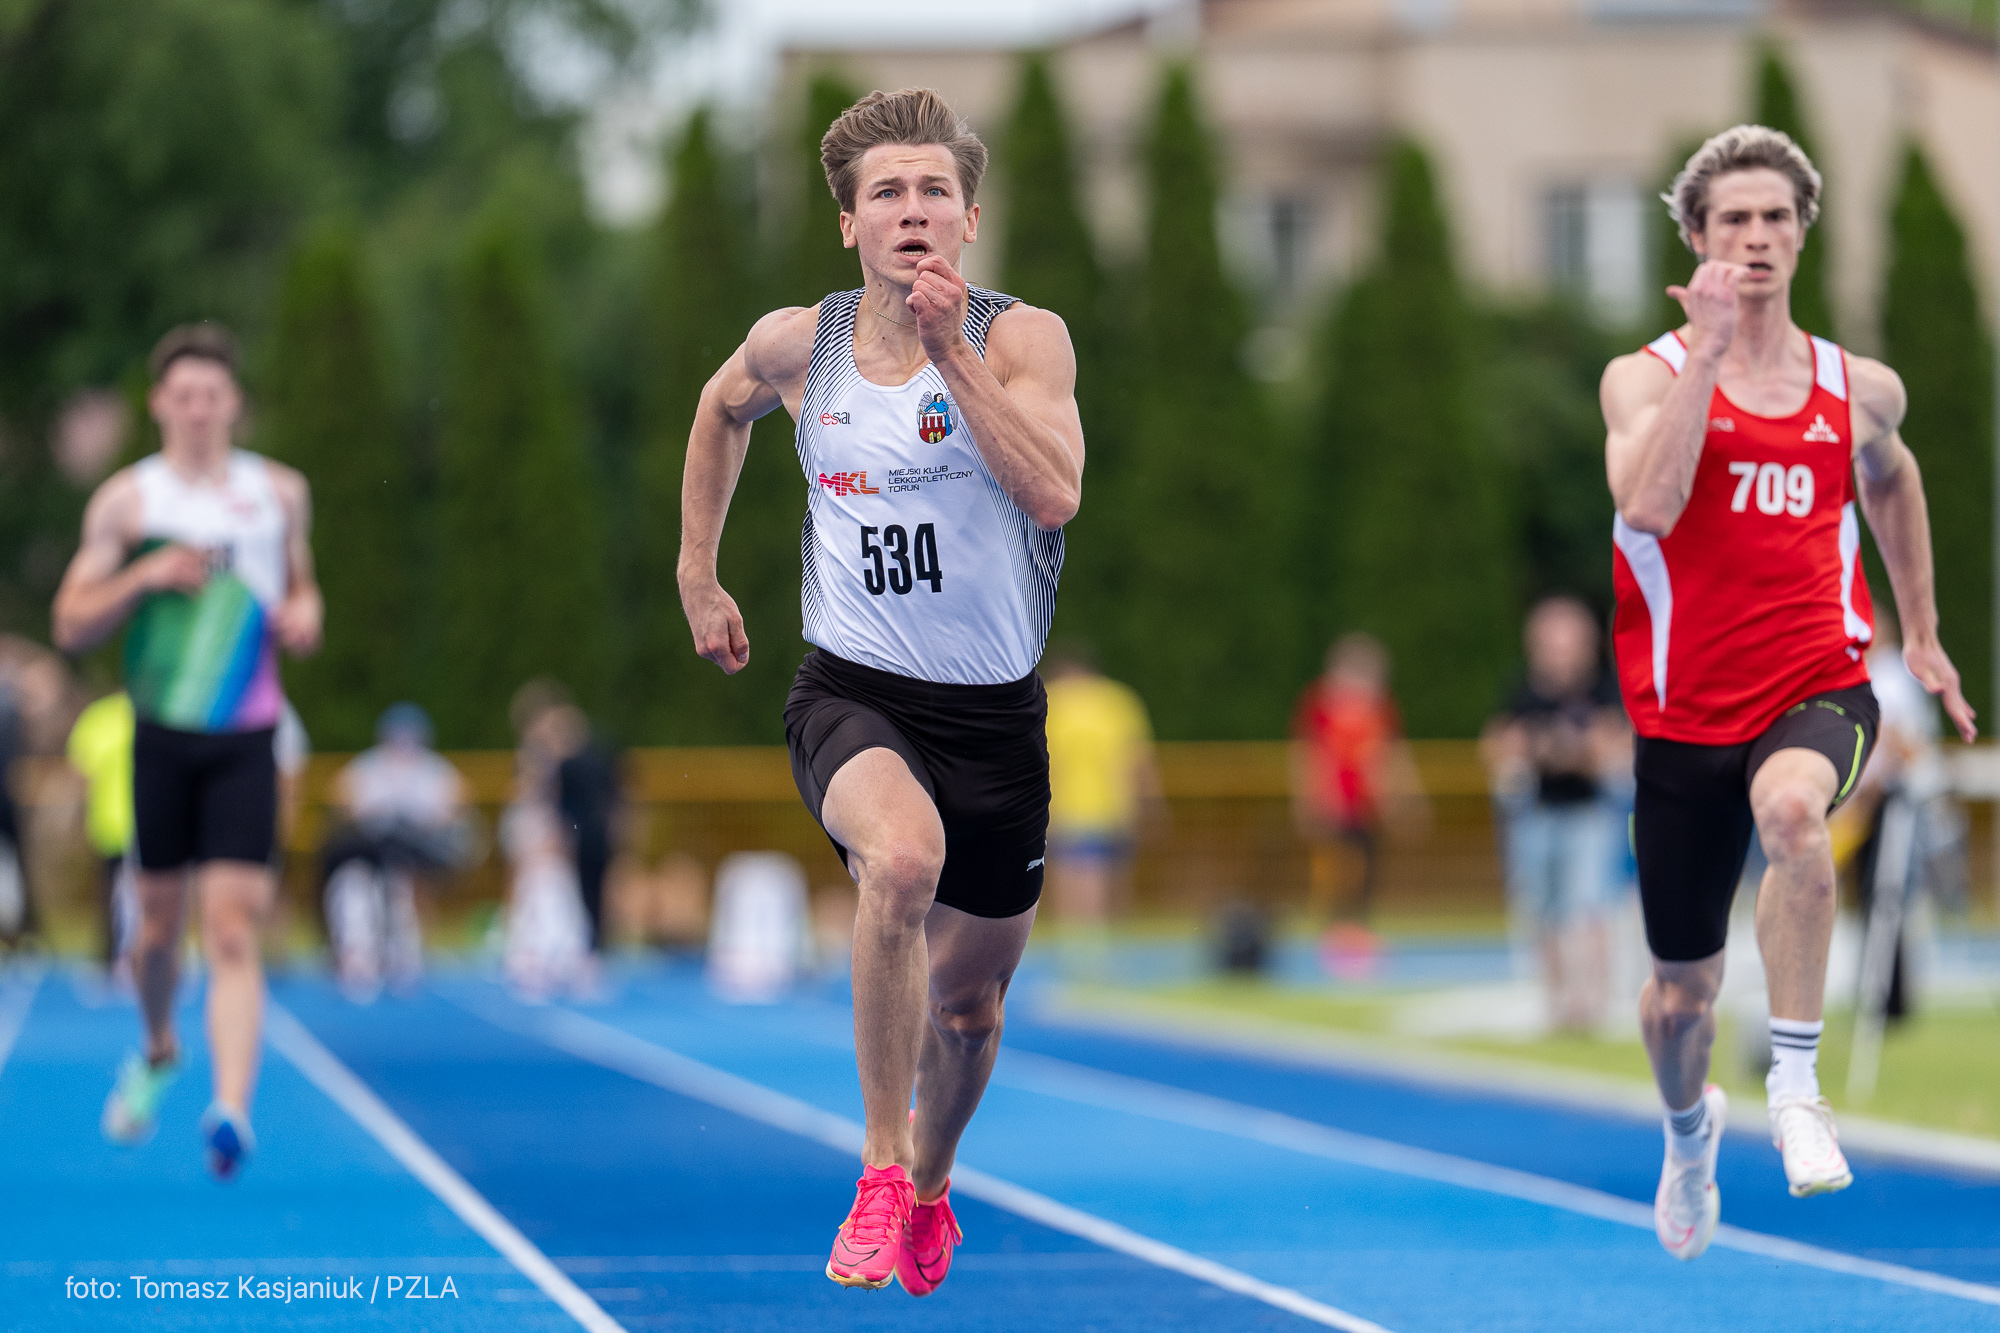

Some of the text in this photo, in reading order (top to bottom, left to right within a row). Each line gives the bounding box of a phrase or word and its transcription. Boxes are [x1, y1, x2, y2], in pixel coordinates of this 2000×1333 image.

[888, 470, 974, 484] LEKKOATLETYCZNY
[889, 465, 948, 476] MIEJSKI KLUB
[819, 471, 879, 496] MKL
[888, 484, 919, 493] TORUŃ
[1729, 461, 1814, 518] 709
[860, 523, 943, 596] 534
